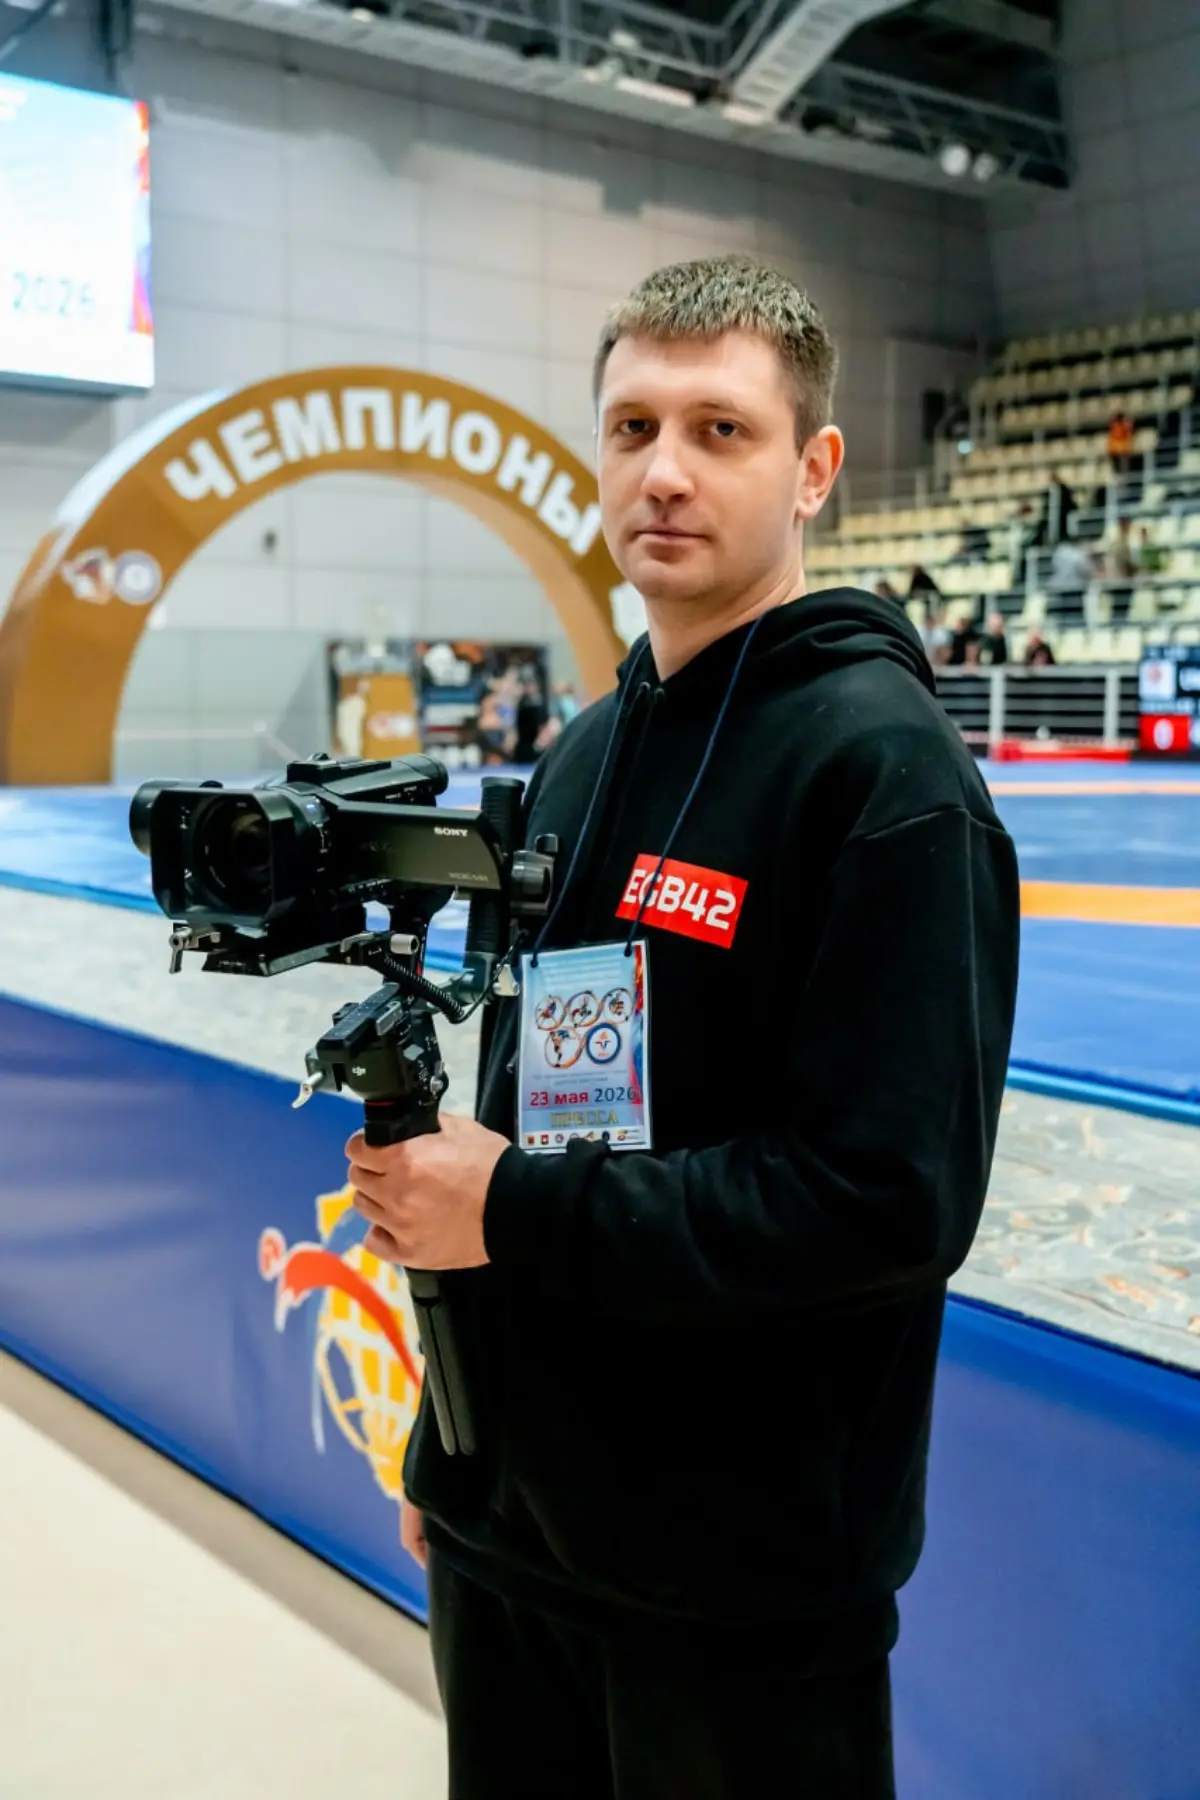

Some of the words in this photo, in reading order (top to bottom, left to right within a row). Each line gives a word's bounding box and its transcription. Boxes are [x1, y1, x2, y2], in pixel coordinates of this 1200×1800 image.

[164, 387, 600, 556] ЧЕМПИОНЫ
[433, 826, 469, 838] SONY
[529, 1091, 549, 1107] 23
[554, 1091, 589, 1105] мая
[594, 1086, 638, 1103] 2026
